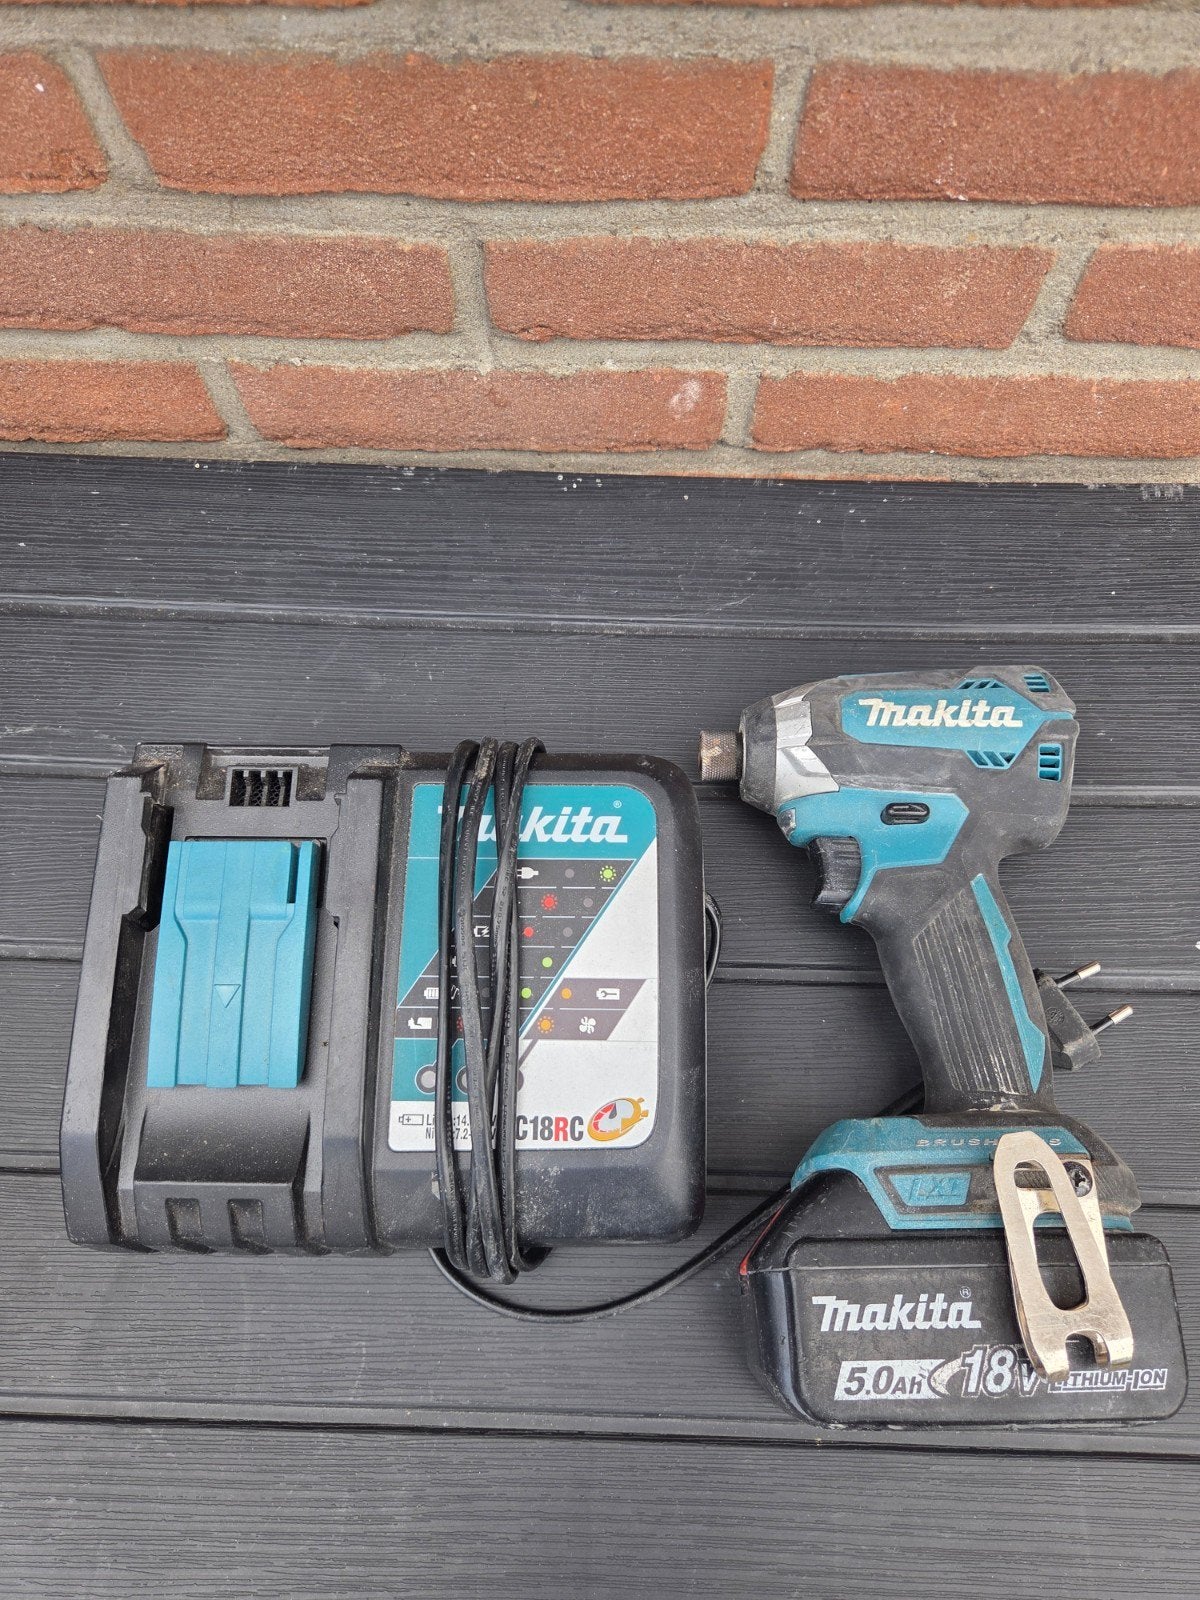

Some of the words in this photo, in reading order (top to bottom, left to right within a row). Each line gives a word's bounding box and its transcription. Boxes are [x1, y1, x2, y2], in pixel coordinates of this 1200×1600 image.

[858, 698, 1023, 728] Makita
[515, 1114, 584, 1142] C18RC
[915, 1137, 1062, 1148] BRUSHS
[812, 1294, 981, 1333] Makita
